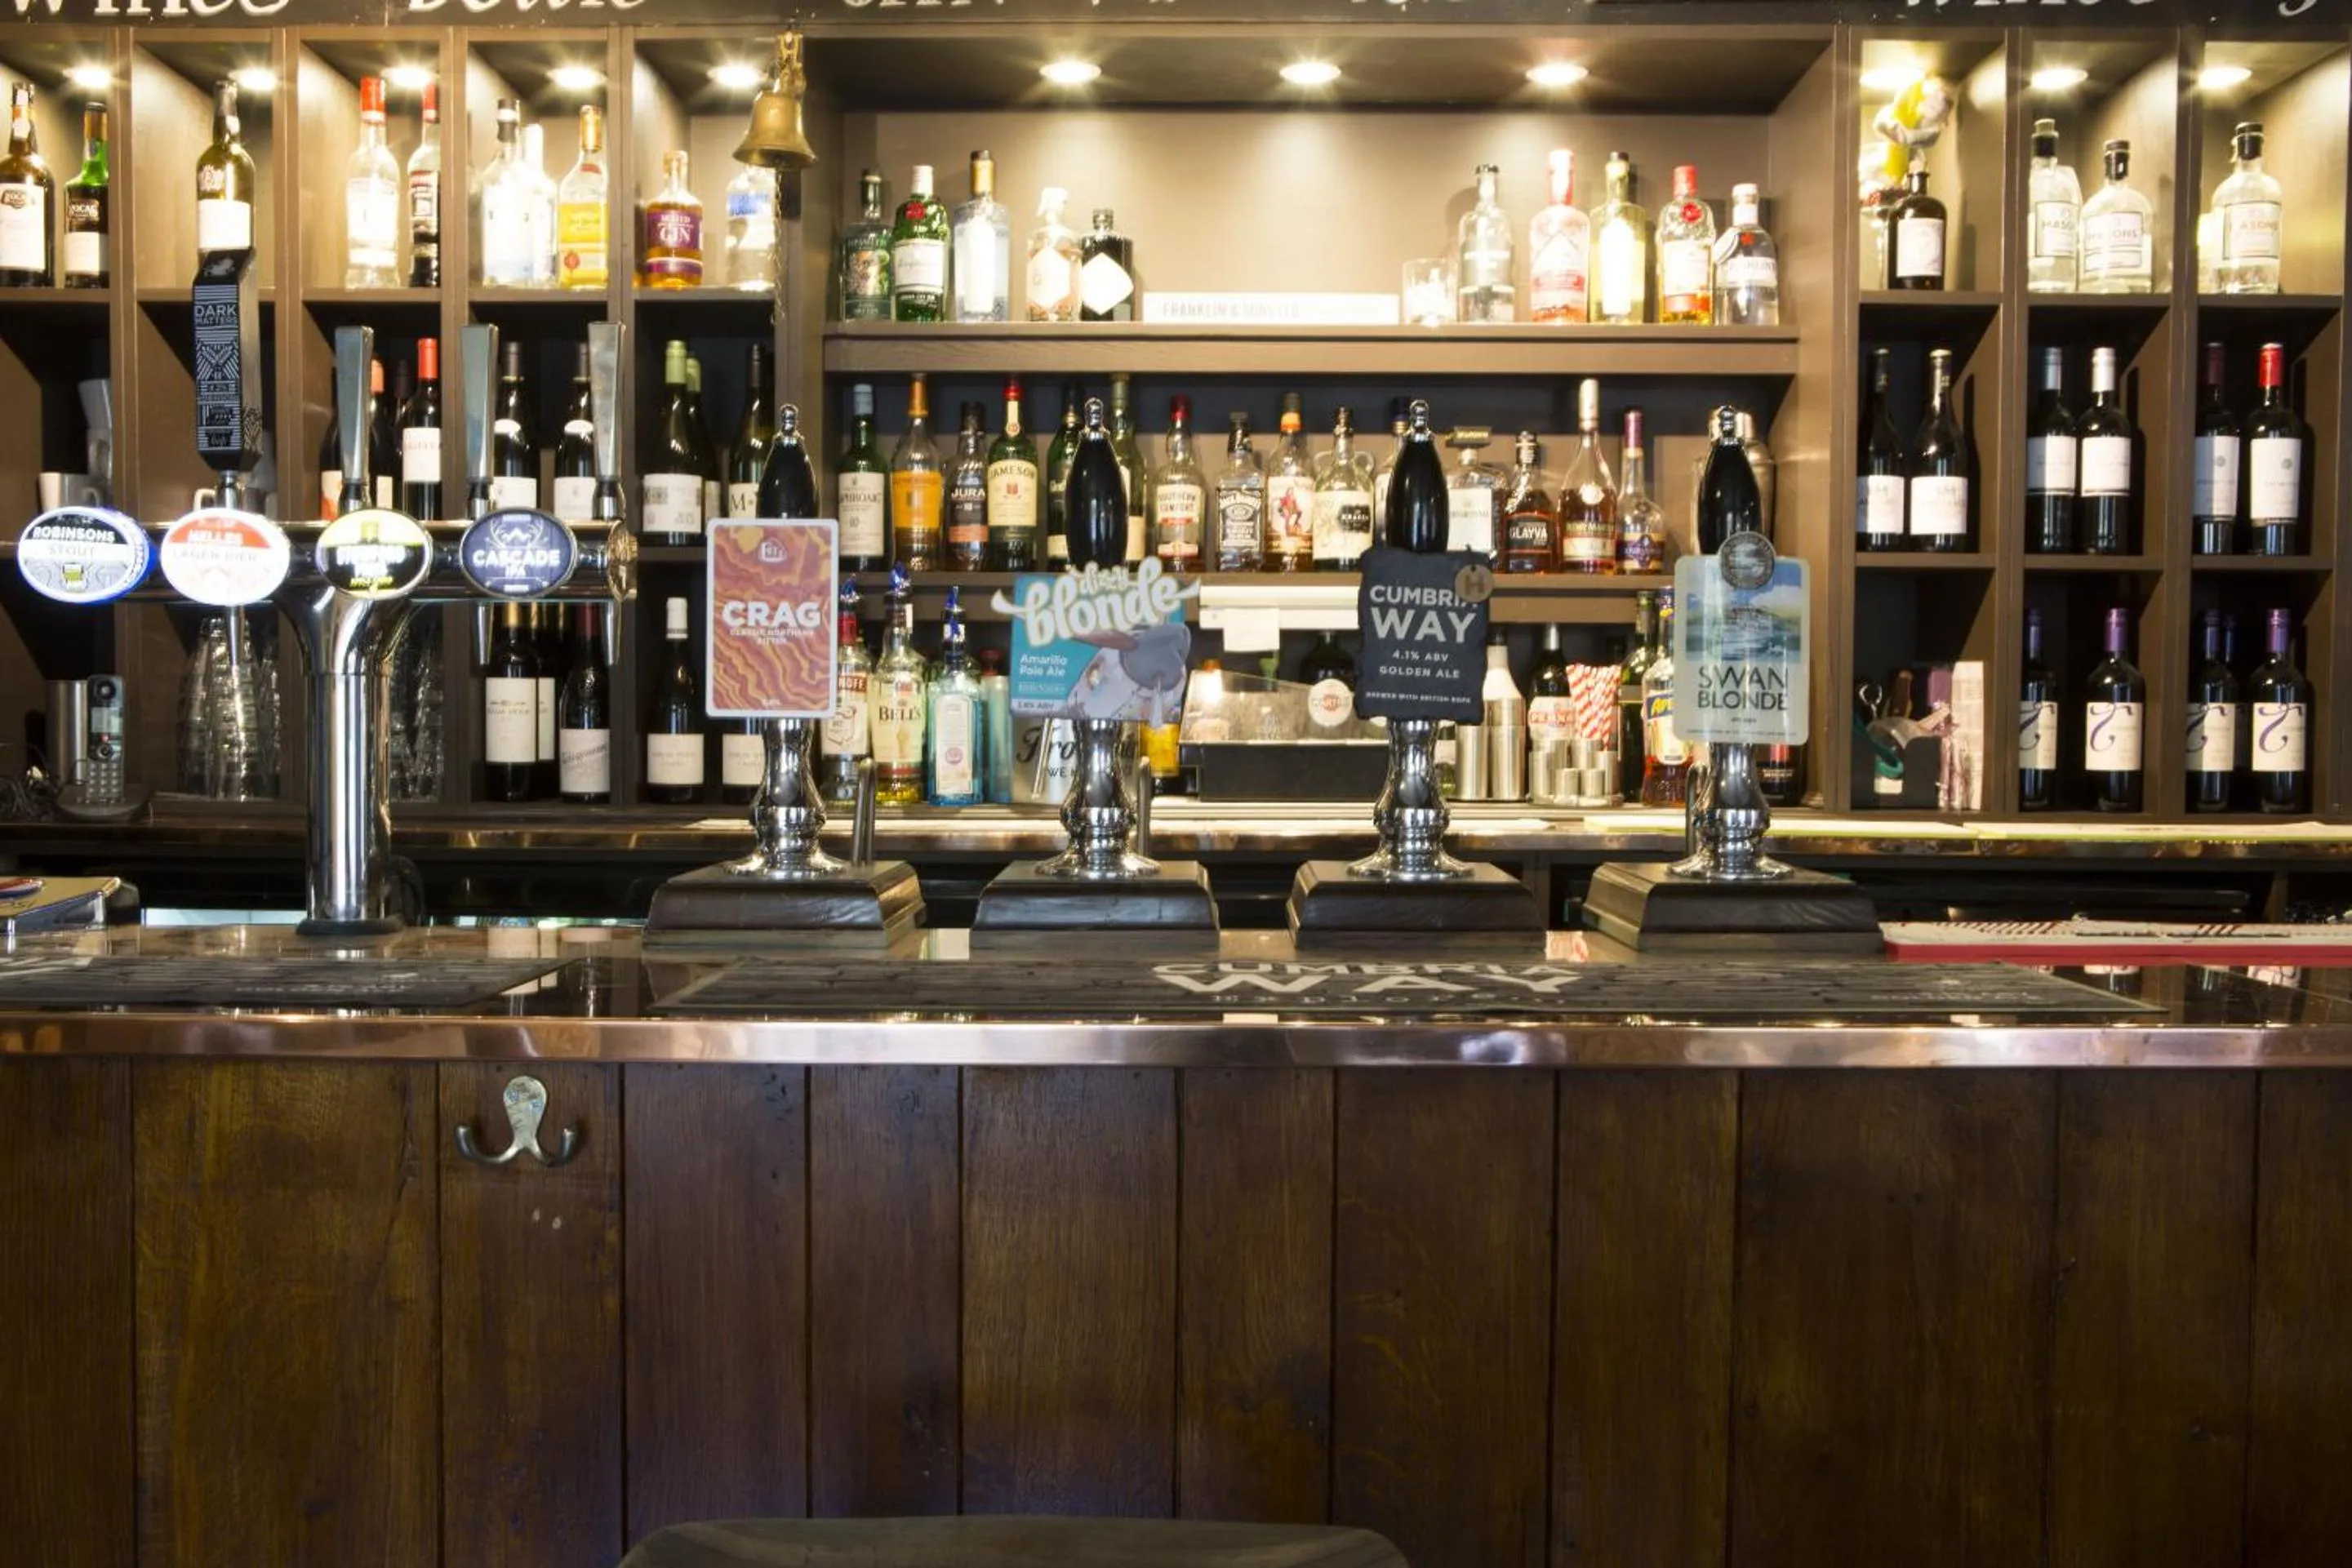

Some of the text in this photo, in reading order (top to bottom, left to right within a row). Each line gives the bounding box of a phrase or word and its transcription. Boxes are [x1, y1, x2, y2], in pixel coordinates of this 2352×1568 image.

[659, 227, 691, 243] GIN
[194, 304, 237, 317] DARK
[1163, 301, 1226, 318] FRANKLIN
[951, 488, 985, 499] JURA
[32, 526, 115, 543] ROBINSONS
[1509, 526, 1548, 539] GLAYVA
[48, 543, 95, 557] STOUT
[473, 549, 561, 566] CASCADE
[991, 556, 1201, 647] blonde
[722, 601, 821, 628] CRAG
[1371, 607, 1477, 643] WAY
[1020, 652, 1068, 666] Amarillo
[1392, 651, 1449, 662] 4.1% ABV
[1020, 664, 1066, 676] Pale Ale
[1379, 666, 1461, 679] GOLDEN ALE
[1698, 666, 1789, 690] SWAN
[838, 677, 865, 691] NOFF
[1697, 691, 1789, 711] BLONDE
[878, 705, 922, 722] BELL'S
[1152, 962, 1581, 975] CUMBRIA
[1156, 974, 1584, 993] WAY
